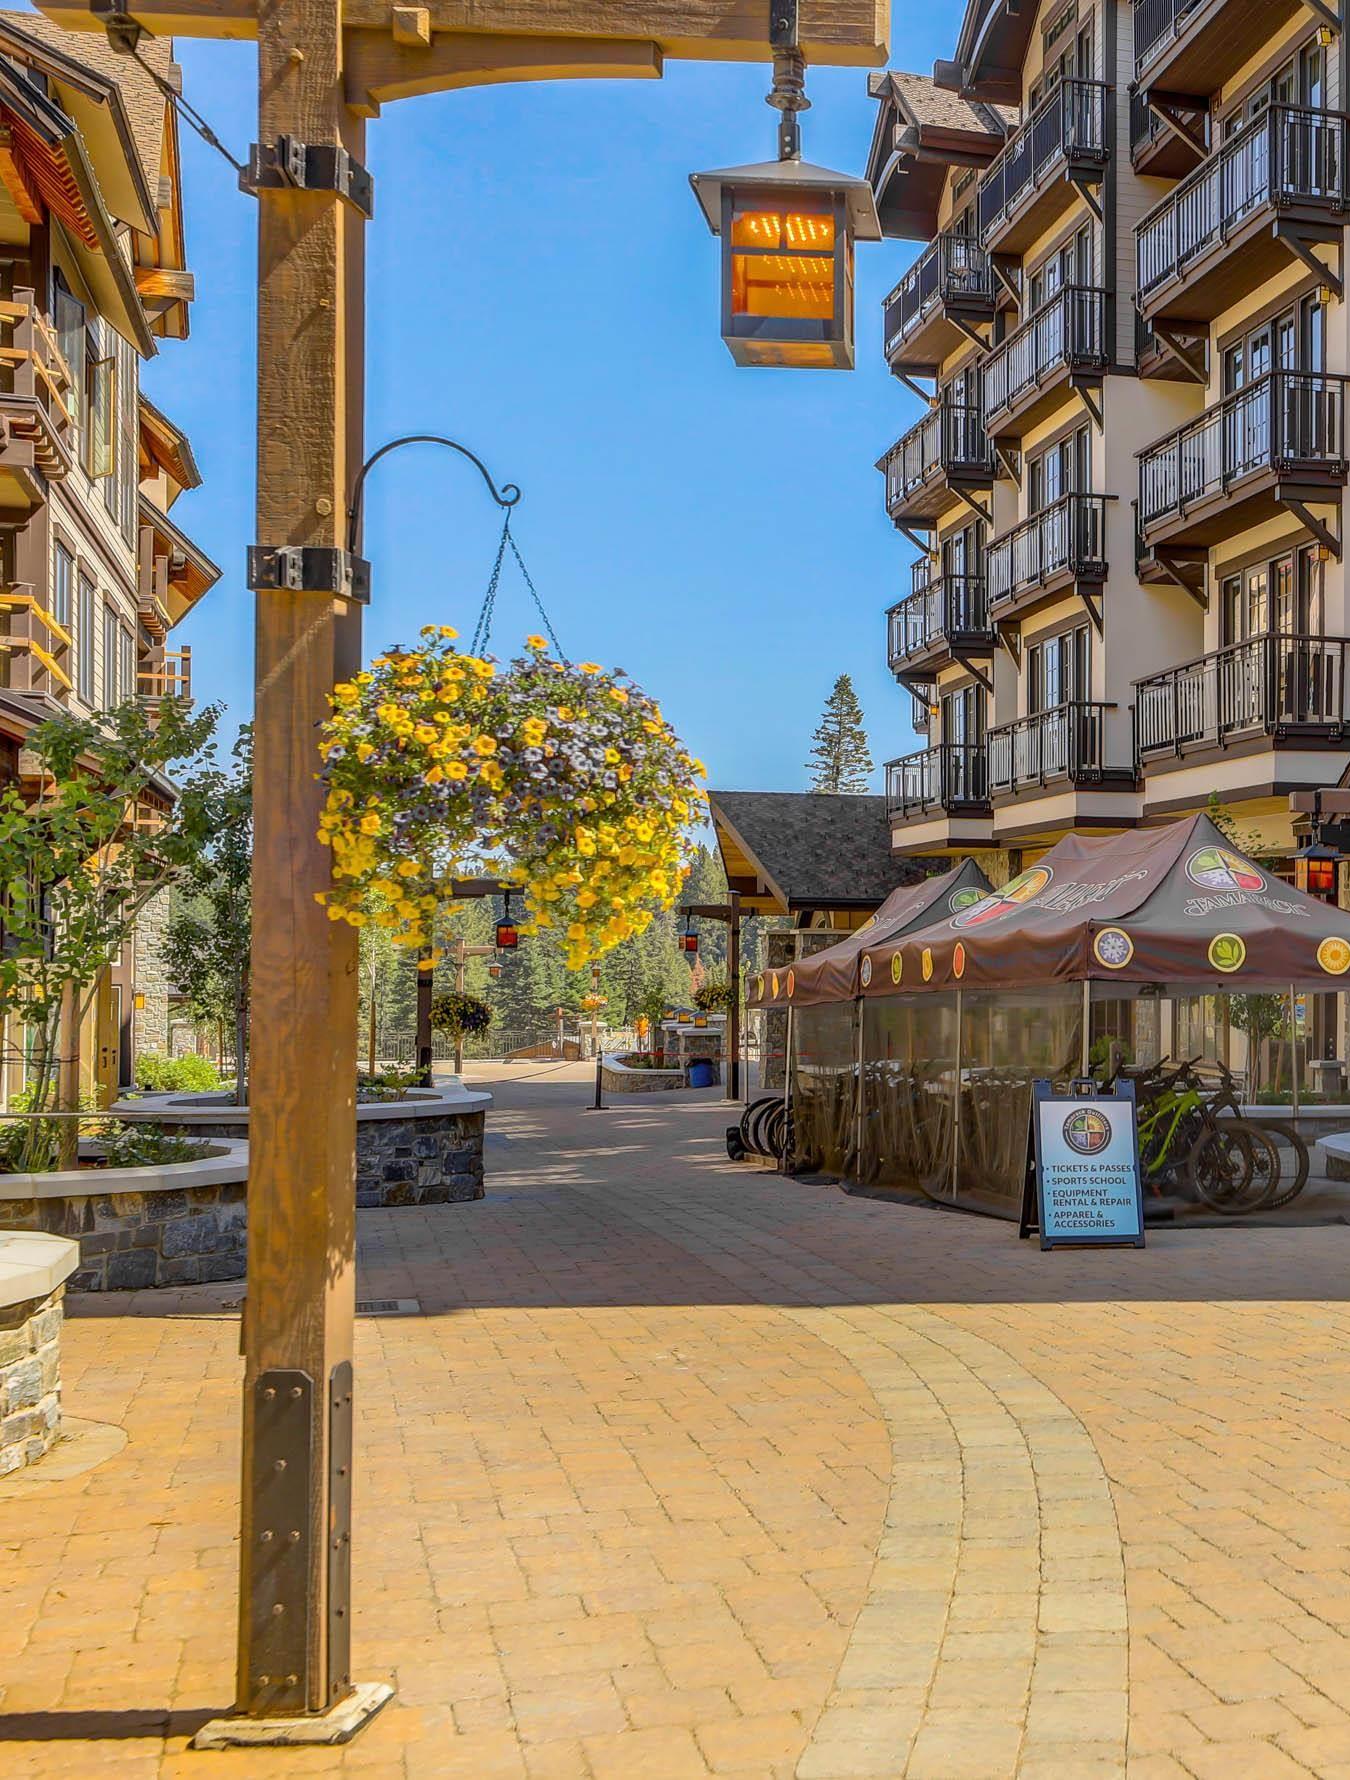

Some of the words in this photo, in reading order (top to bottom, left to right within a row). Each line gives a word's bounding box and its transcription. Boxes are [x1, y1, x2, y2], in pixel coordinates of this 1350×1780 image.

[1184, 891, 1311, 917] TAMARACK
[1052, 1177, 1088, 1185] SPORTS
[1089, 1177, 1127, 1185] SCHOOL
[1053, 1189, 1108, 1198] EQUIPMENT
[1054, 1211, 1095, 1219] APPAREL
[1054, 1220, 1115, 1228] ACCESSORIES
